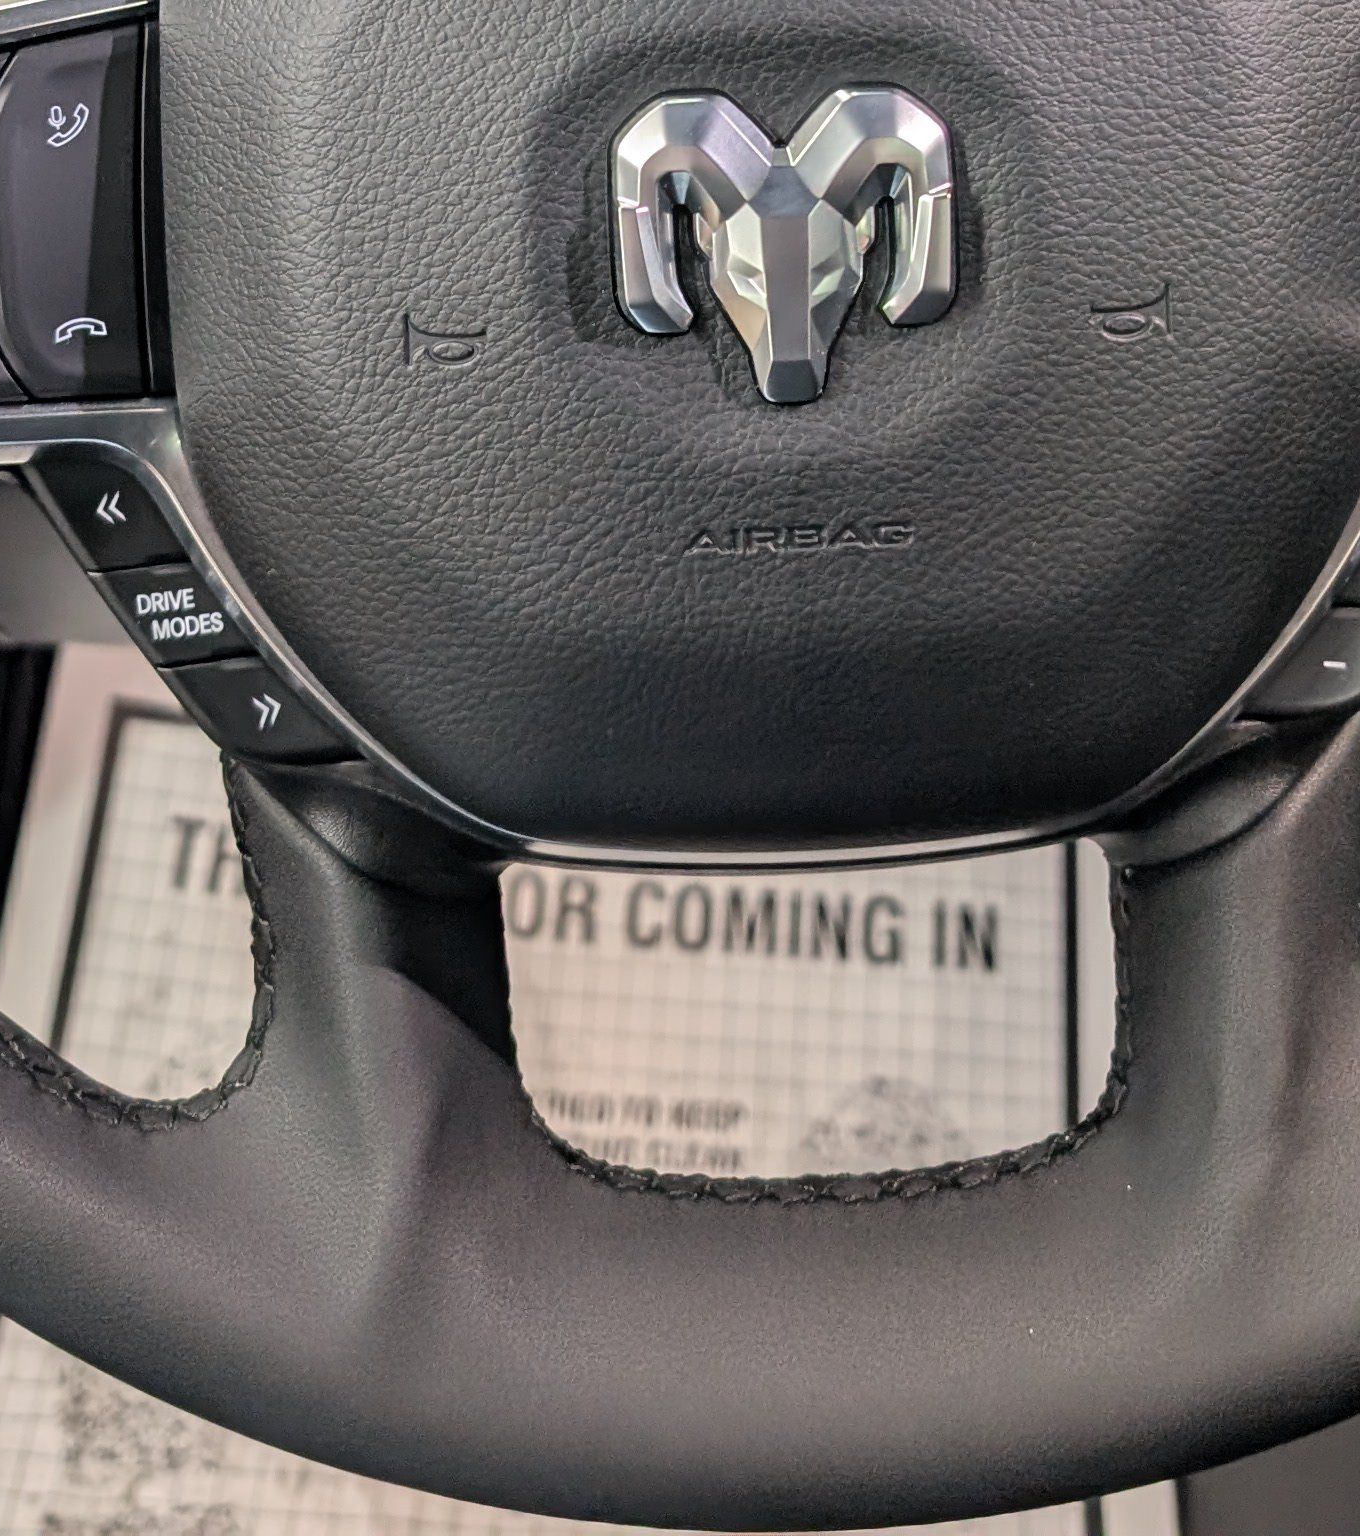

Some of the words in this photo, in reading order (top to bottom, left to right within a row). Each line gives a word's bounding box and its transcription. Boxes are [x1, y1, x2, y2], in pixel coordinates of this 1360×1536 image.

[683, 524, 917, 557] AIRBAG
[136, 587, 196, 615] DRIVE
[152, 611, 224, 640] MODES
[625, 878, 905, 964] COMING
[932, 898, 999, 972] IN
